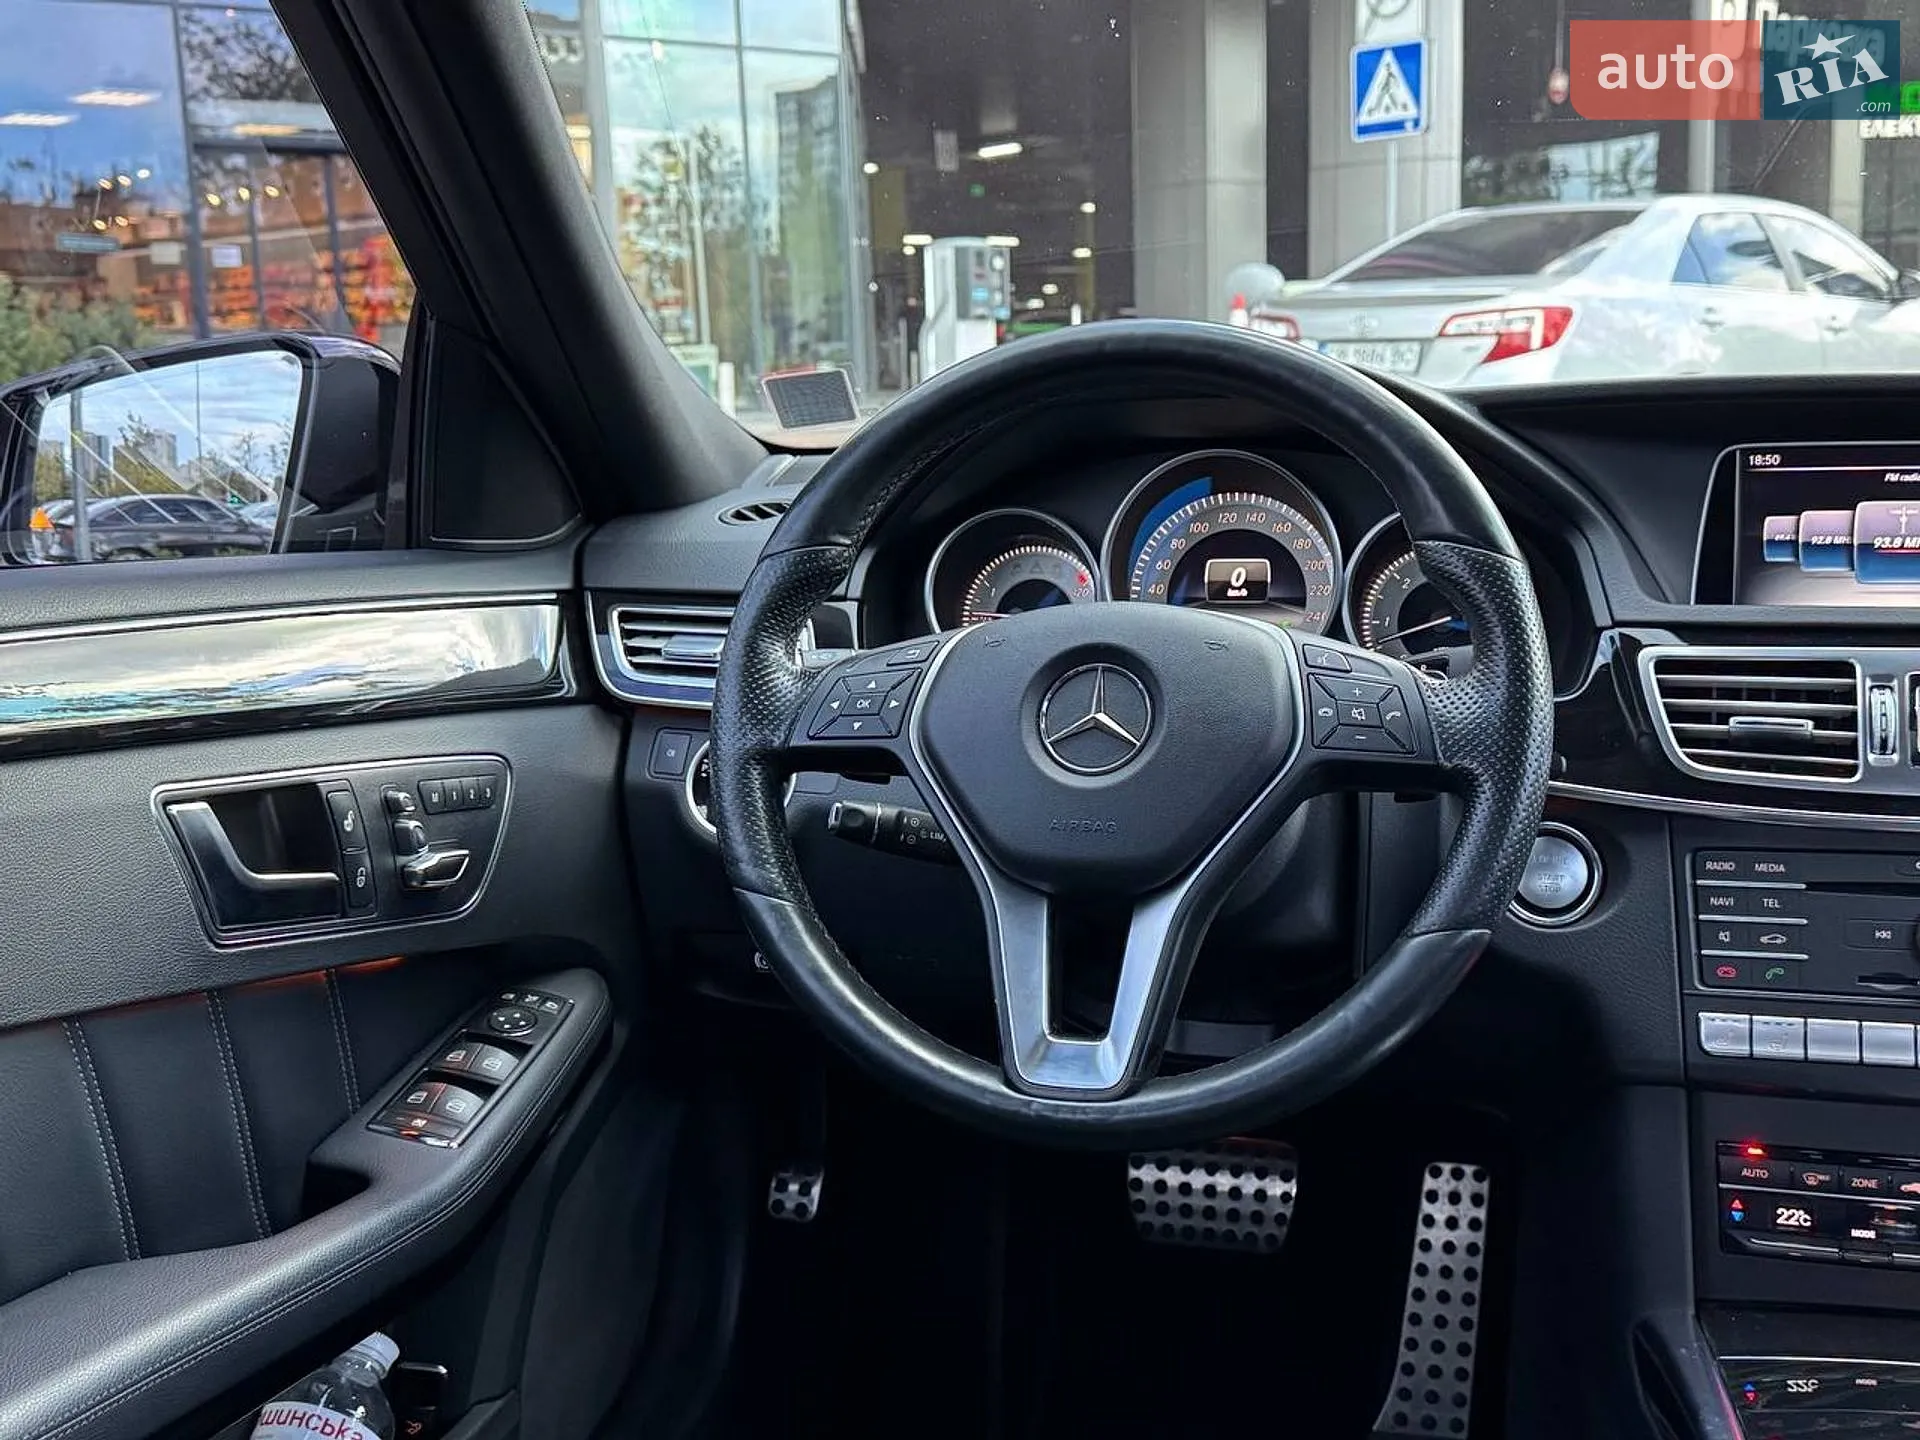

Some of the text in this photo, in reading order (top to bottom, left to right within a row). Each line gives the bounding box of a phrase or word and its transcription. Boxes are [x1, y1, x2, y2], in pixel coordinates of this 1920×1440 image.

[1748, 454, 1780, 466] 18:50
[1217, 512, 1237, 523] 120
[1244, 512, 1266, 523] 140
[1189, 522, 1209, 534] 100
[1272, 522, 1292, 533] 160
[1169, 538, 1186, 550] 80
[1292, 538, 1312, 549] 180
[1155, 559, 1172, 570] 60
[1304, 559, 1326, 571] 200
[1230, 567, 1247, 588] 0
[1402, 577, 1411, 589] 2
[1148, 584, 1165, 594] 40
[1309, 584, 1332, 595] 220
[856, 698, 872, 709] OK
[1048, 818, 1118, 834] AIRBAG
[1705, 861, 1736, 871] RADIO
[1754, 862, 1786, 873] MEDIA
[1709, 896, 1734, 907] NAVI
[1762, 898, 1781, 908] TEL
[1741, 1167, 1769, 1179] AUTO
[1851, 1177, 1880, 1189] ZONE
